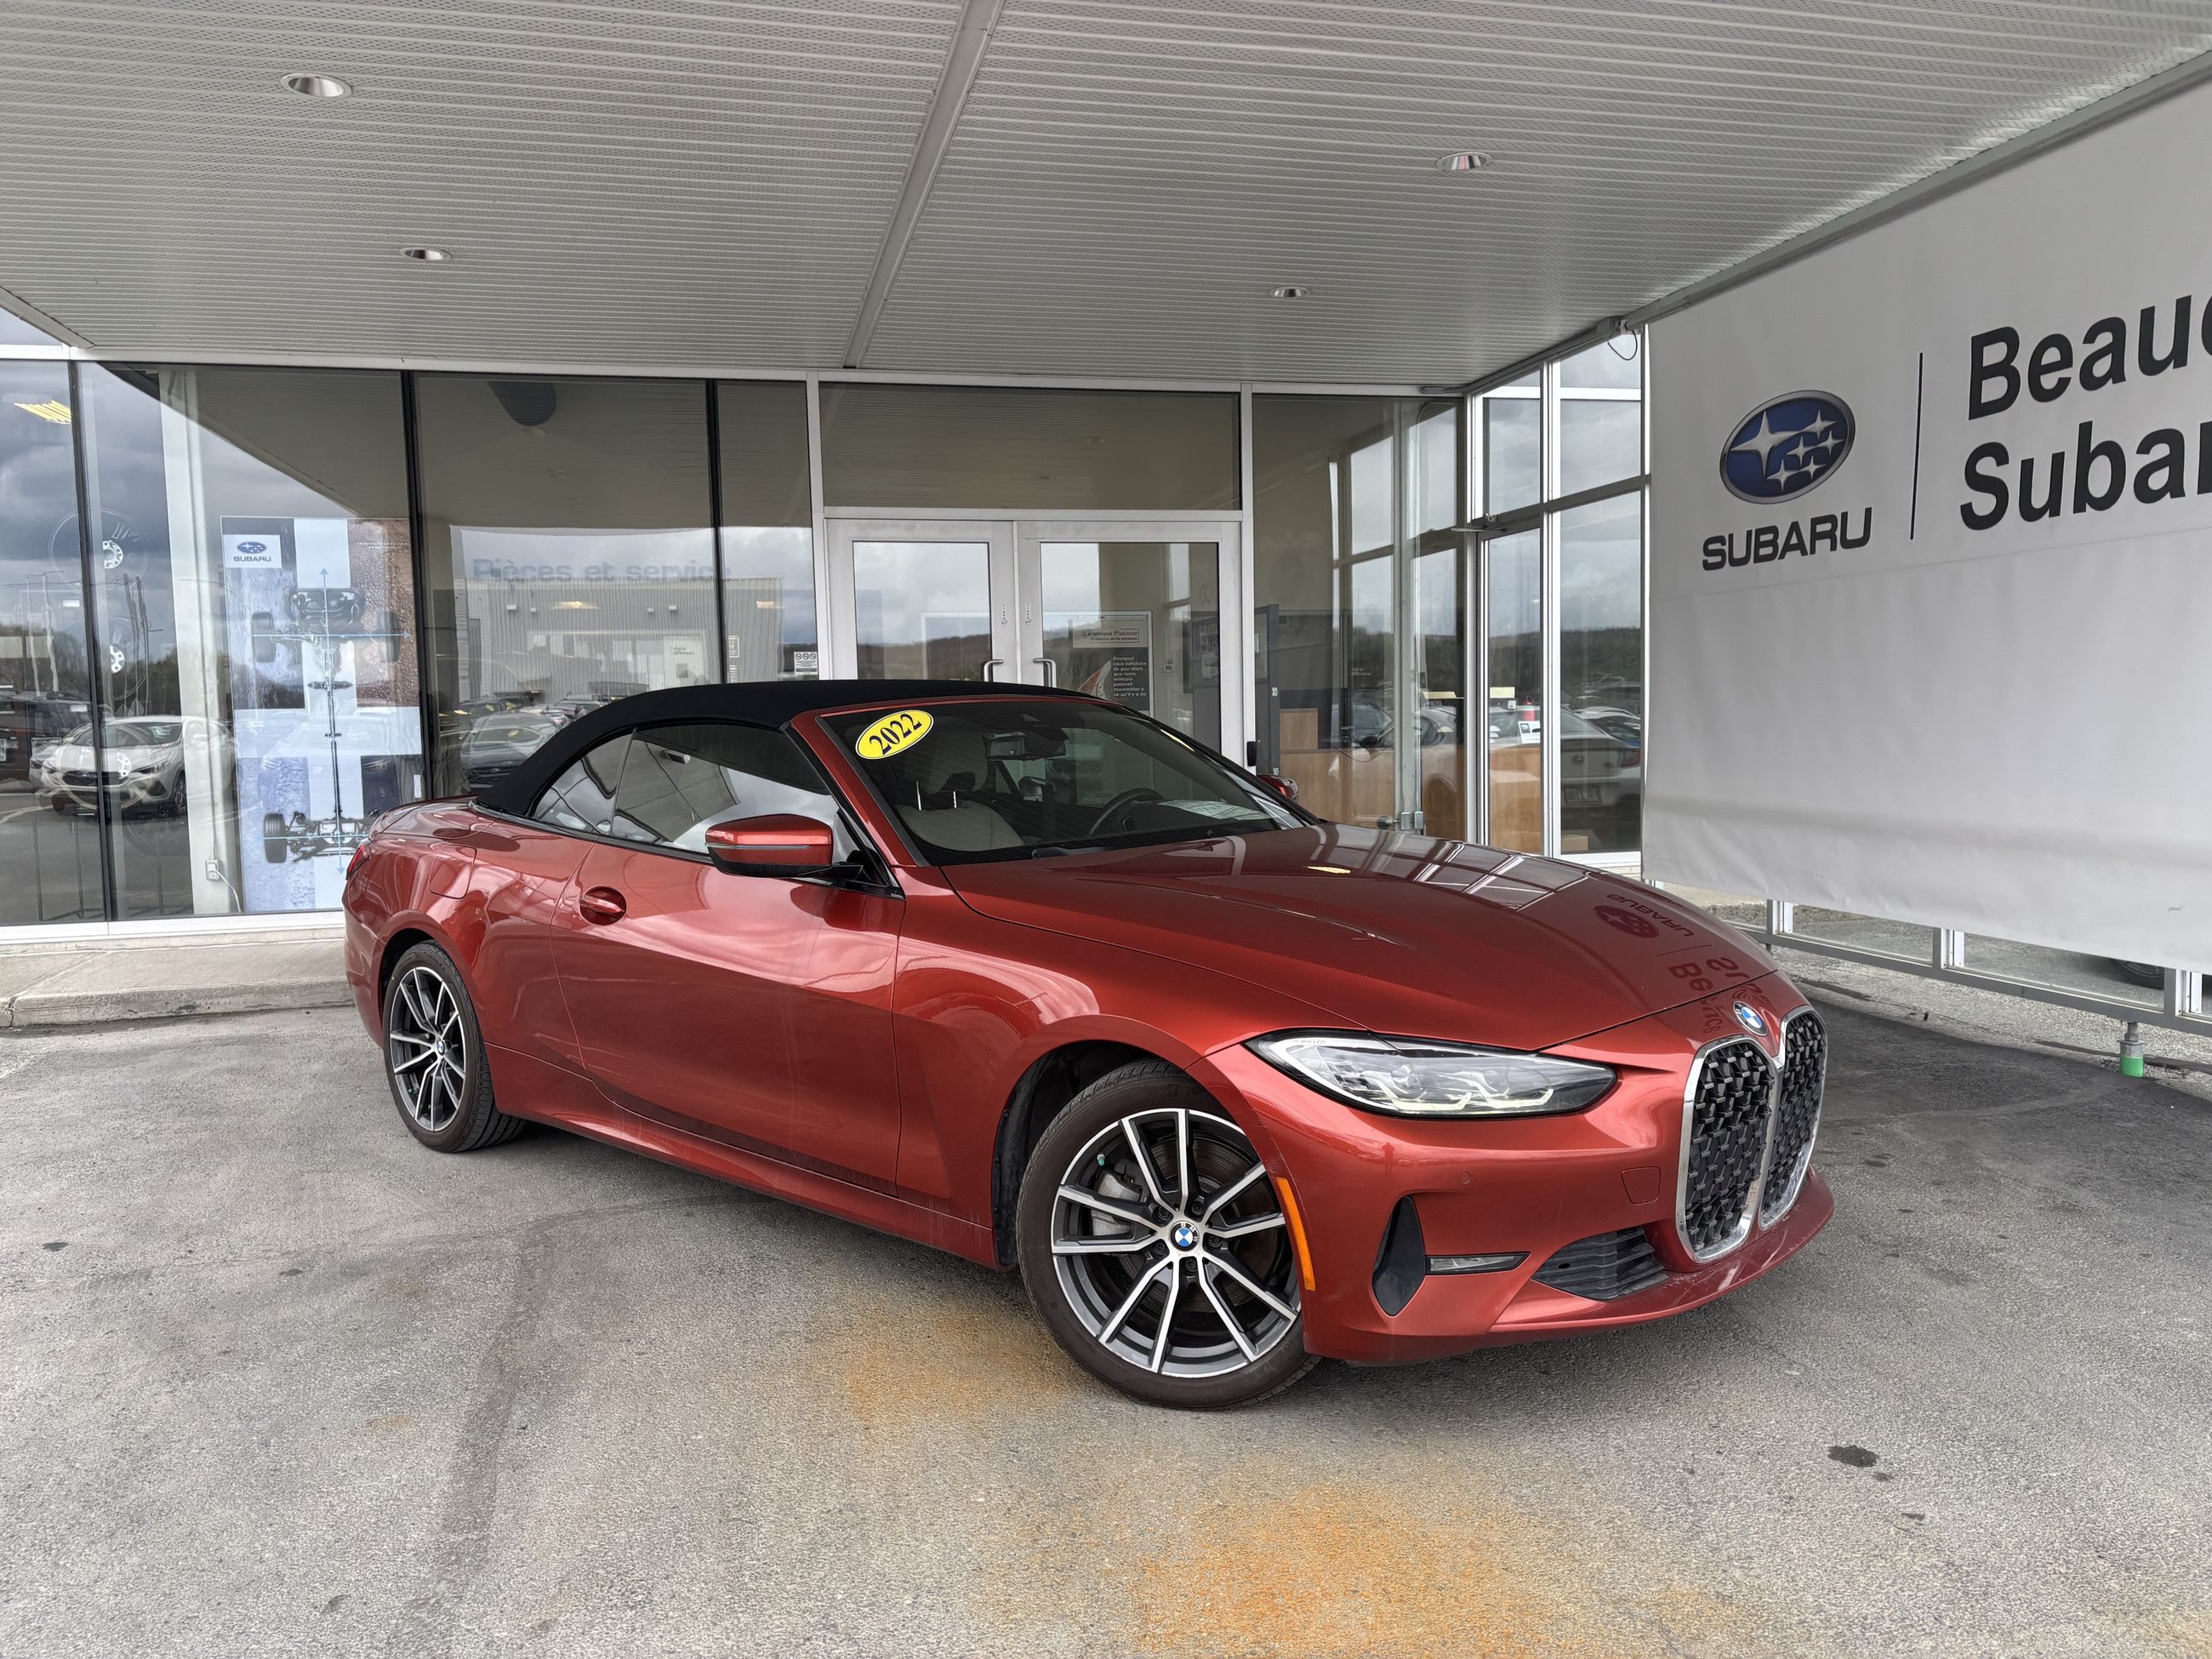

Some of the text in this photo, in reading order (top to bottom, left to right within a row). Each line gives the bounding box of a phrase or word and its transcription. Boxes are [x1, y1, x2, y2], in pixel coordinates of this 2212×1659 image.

[1702, 507, 1872, 571] SUBARU
[473, 558, 572, 581] Pièces
[584, 561, 614, 581] et
[869, 714, 922, 755] 2022
[1180, 1222, 1199, 1242] BMW
